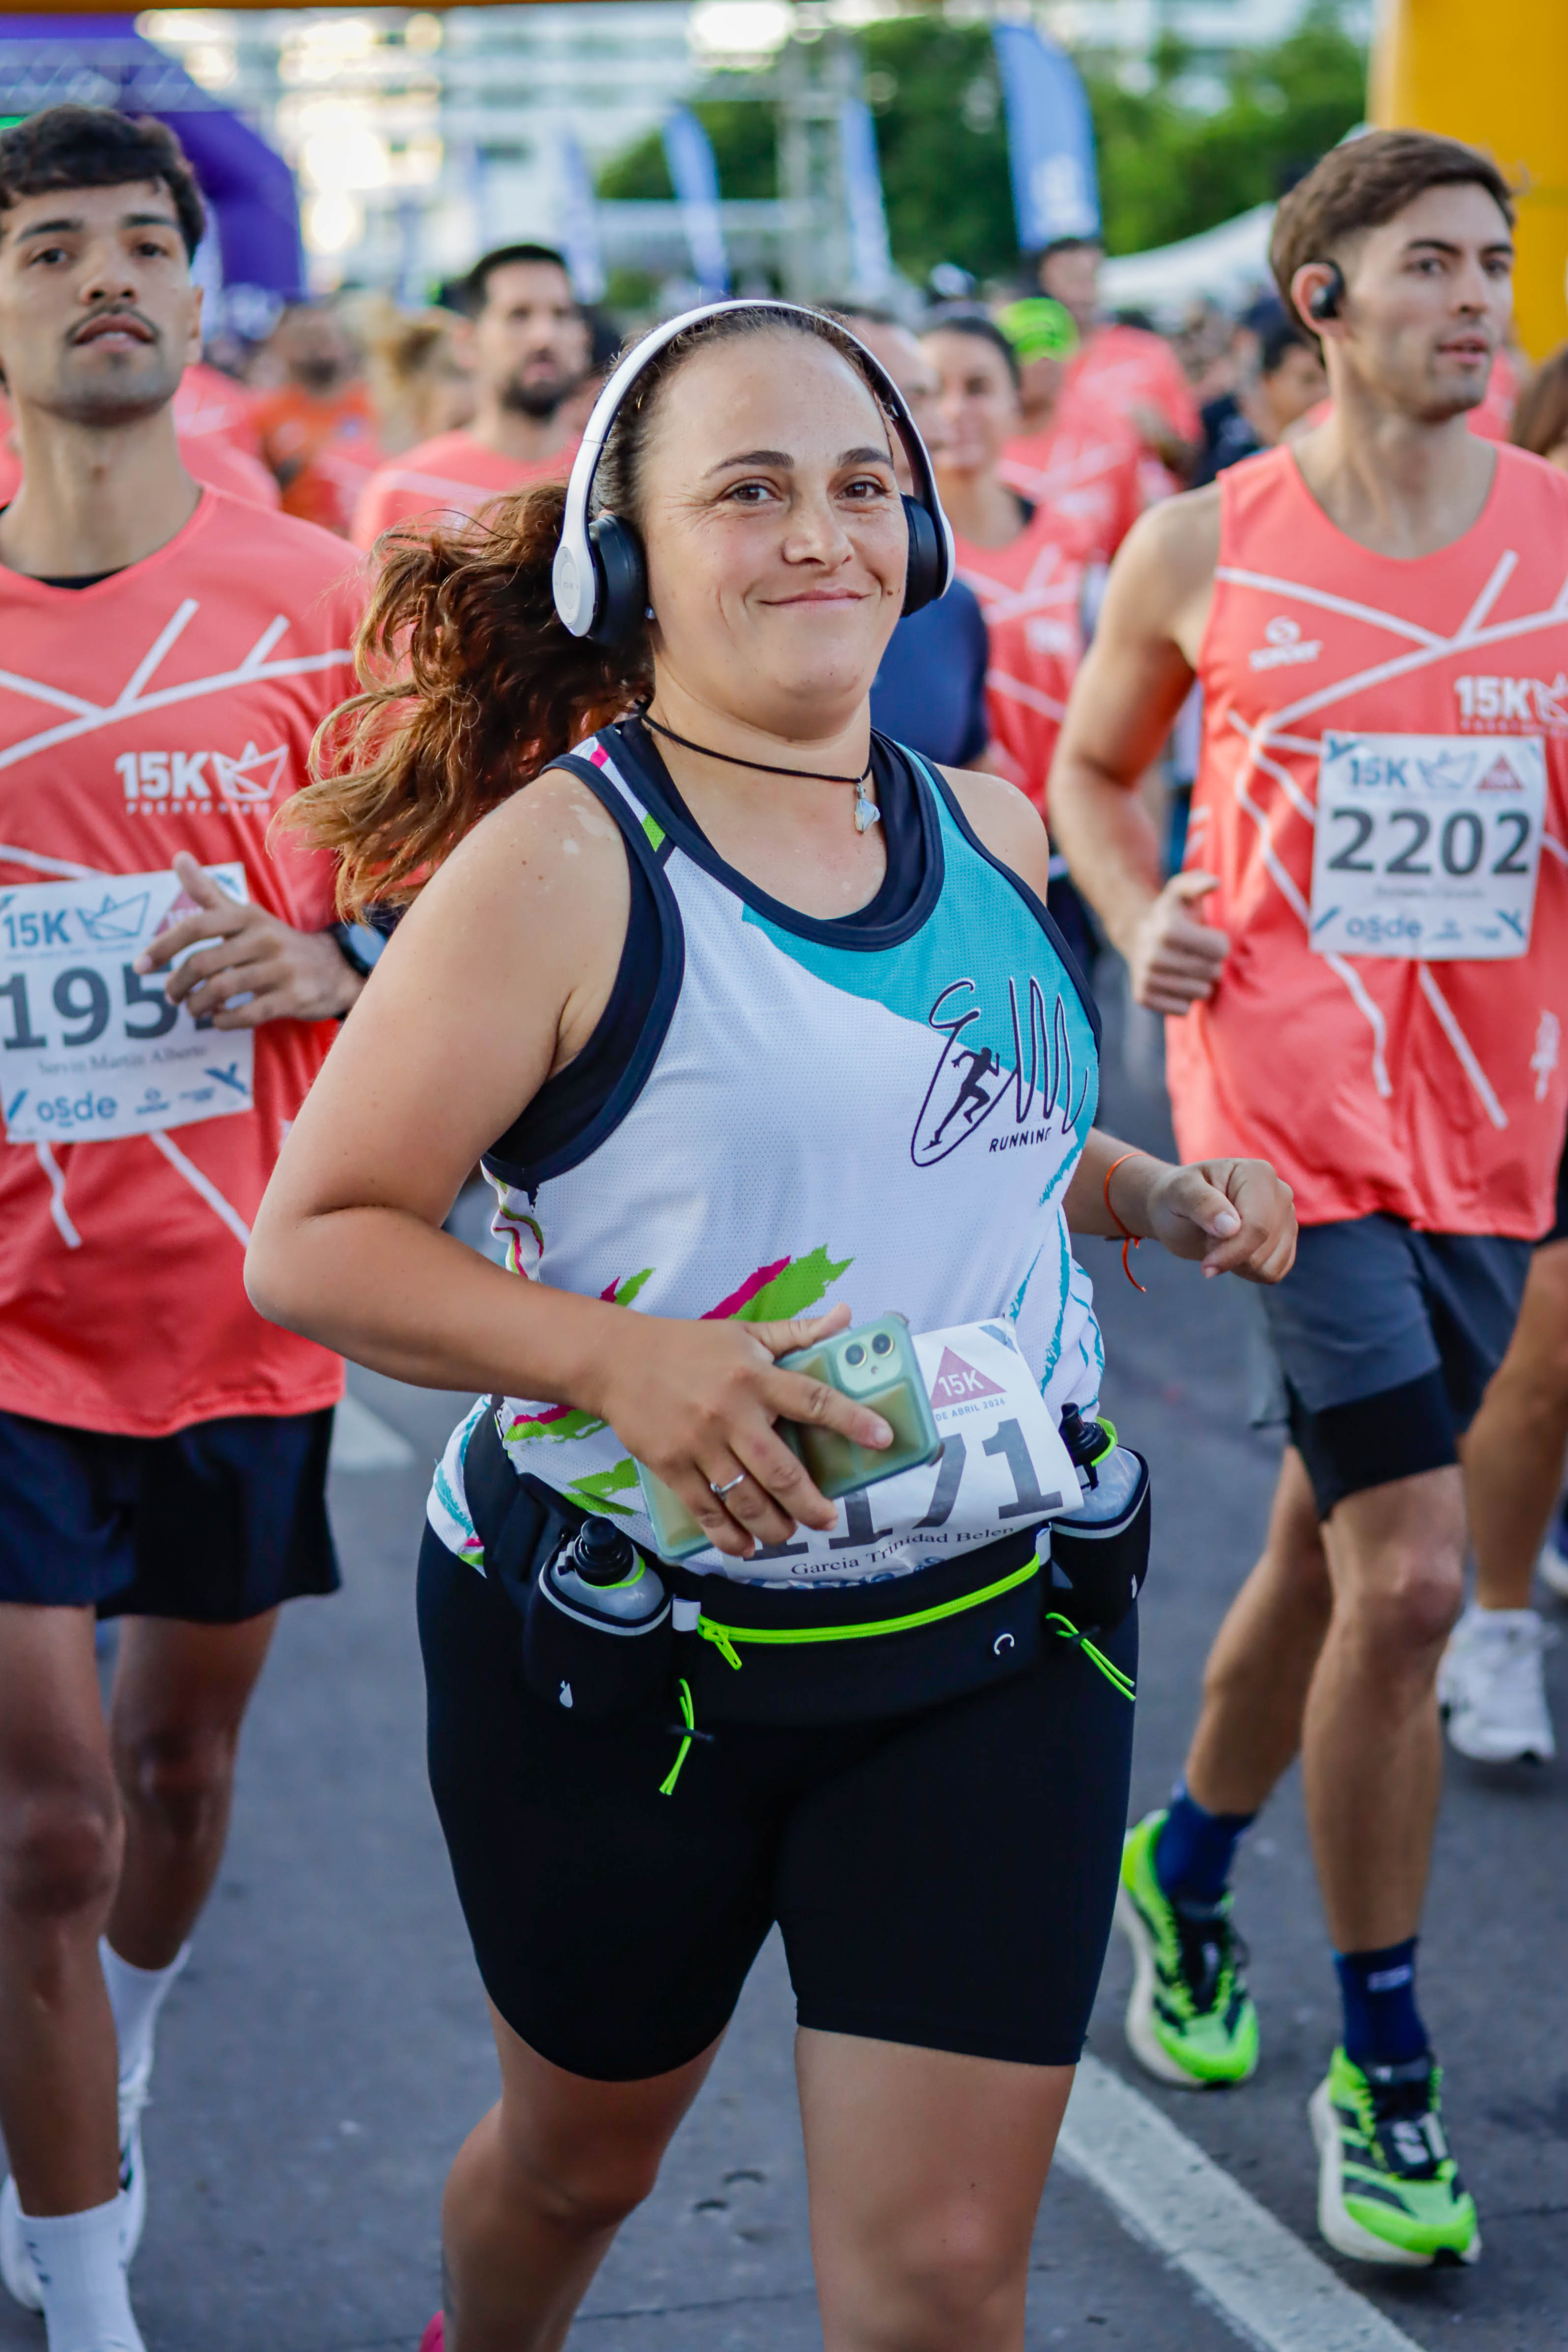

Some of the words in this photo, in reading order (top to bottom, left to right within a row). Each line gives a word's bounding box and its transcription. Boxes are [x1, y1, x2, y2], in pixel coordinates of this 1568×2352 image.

[1453, 675, 1532, 719] 15K
[115, 751, 211, 799] 15K
[1350, 757, 1408, 787] 15K
[1328, 807, 1530, 875] 2202
[3, 910, 71, 948] 15K
[0, 962, 214, 1050] 195
[37, 1090, 117, 1121] osde
[938, 1369, 985, 1397] 15K
[936, 1411, 948, 1422] DE
[951, 1404, 980, 1418] ABRIL
[983, 1397, 1006, 1410] 2026
[791, 1556, 859, 1574] Garcia
[865, 1532, 949, 1564] Trinidad
[956, 1527, 1013, 1543] Belen
